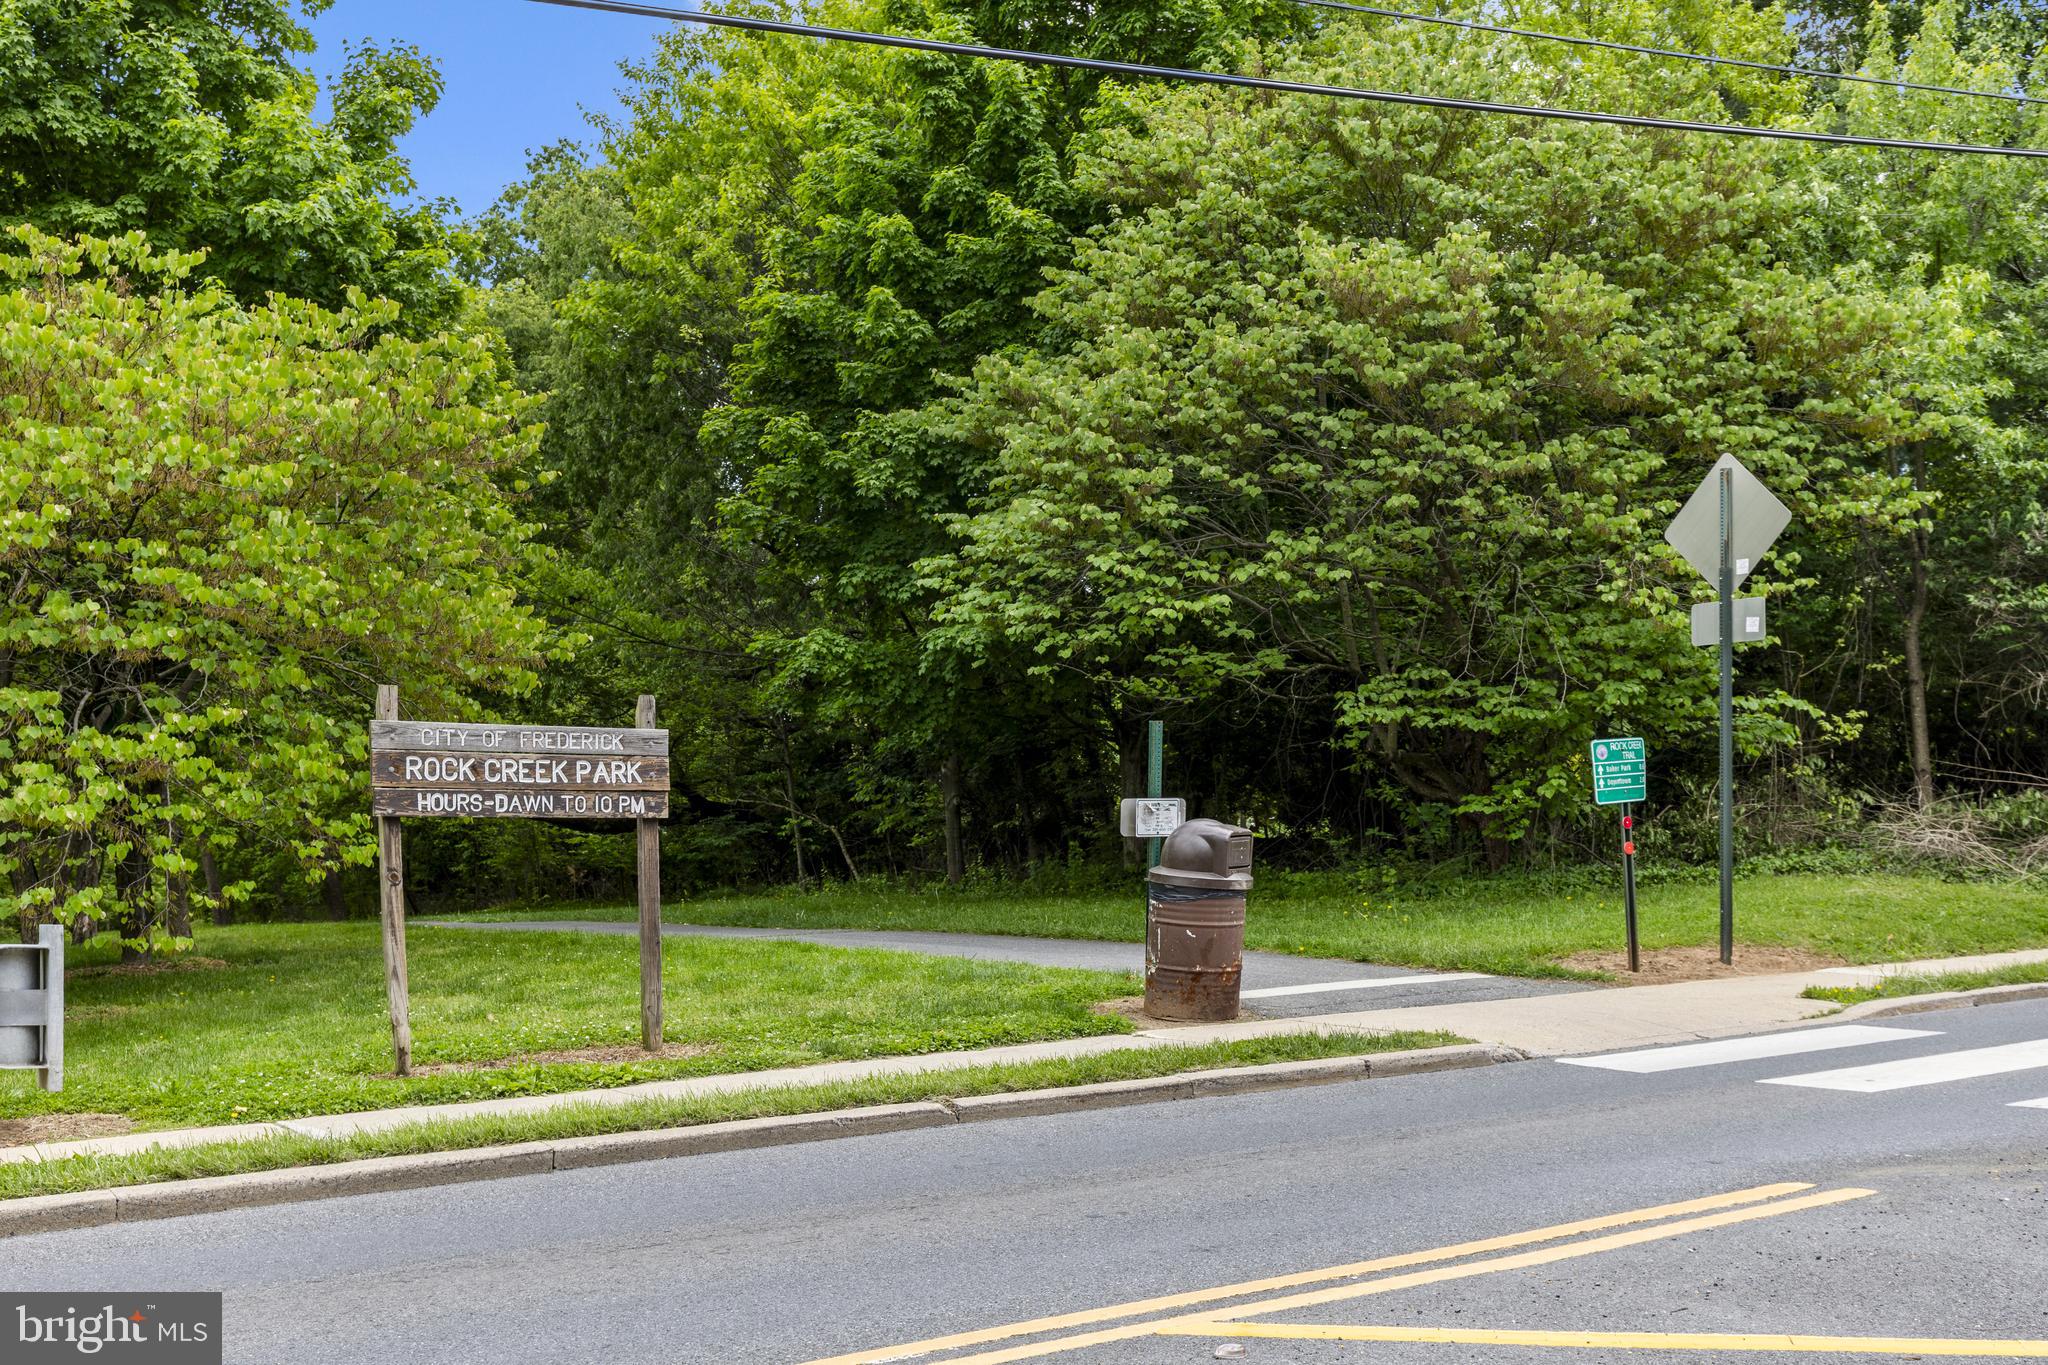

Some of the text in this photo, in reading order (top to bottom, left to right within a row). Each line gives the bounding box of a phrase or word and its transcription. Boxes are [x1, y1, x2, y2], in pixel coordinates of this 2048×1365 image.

[421, 728, 625, 751] CITY OF FREDERICK
[1610, 742, 1627, 751] ROCK
[1622, 751, 1636, 759] TRAIL
[405, 755, 644, 784] ROCK CREEK PARK
[417, 792, 645, 814] HOURS-DAWN TO 10 PM
